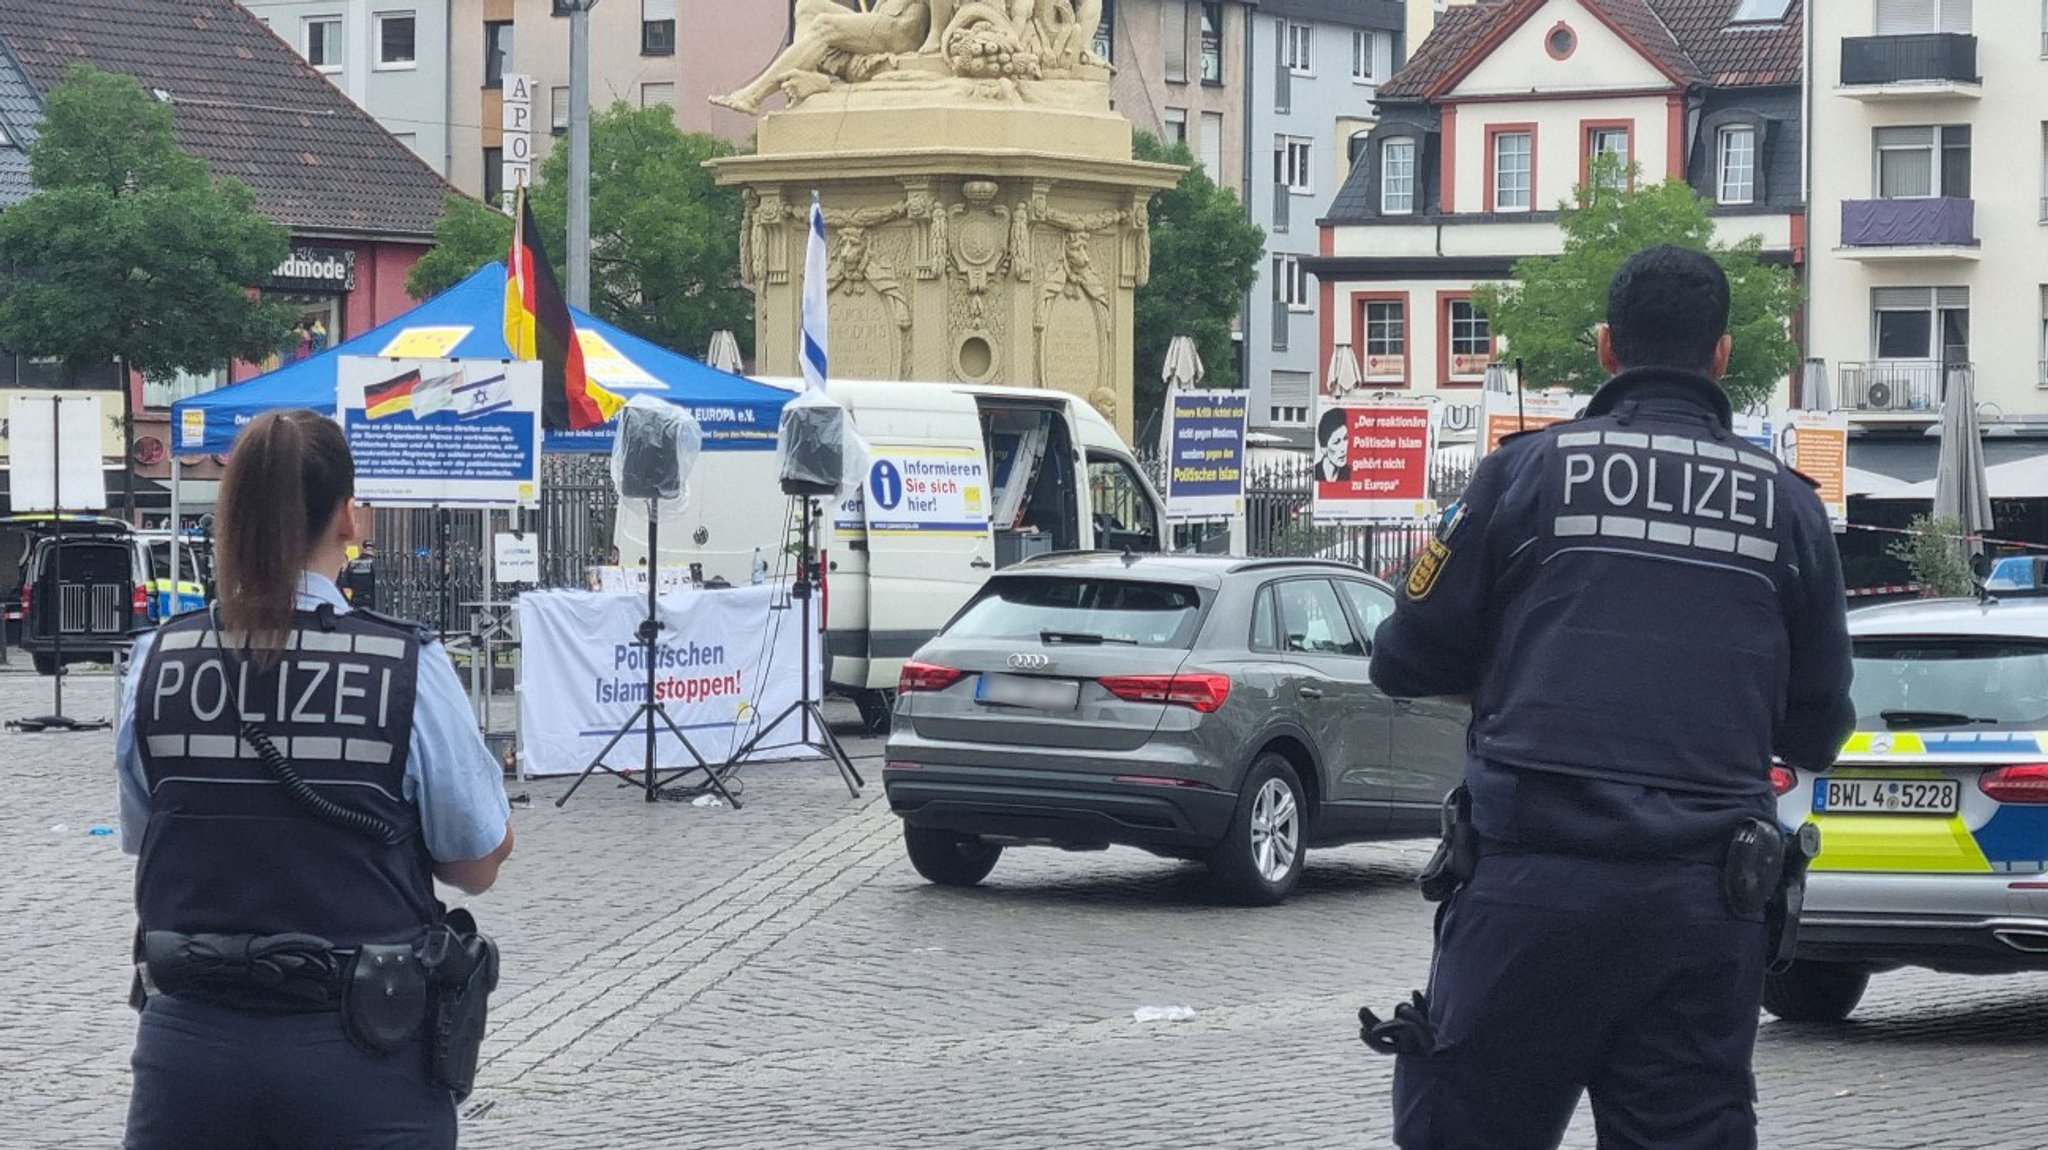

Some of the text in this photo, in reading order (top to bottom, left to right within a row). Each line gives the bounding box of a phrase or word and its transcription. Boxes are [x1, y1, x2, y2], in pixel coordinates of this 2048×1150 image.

[513, 77, 528, 186] APOT
[695, 408, 735, 421] EUROPA
[738, 409, 755, 423] e.V.
[1376, 415, 1426, 428] reaktionäre
[1353, 436, 1422, 449] Politische Islam
[903, 460, 981, 476] Informieren
[1352, 458, 1405, 471] gehört nicht
[1174, 466, 1239, 482] Politischen Islam
[905, 478, 957, 494] Sie sich
[1352, 481, 1362, 491] zu
[1564, 452, 1774, 529] POLIZEI
[907, 497, 938, 512] hier!
[153, 659, 391, 728] POLIZEI
[595, 669, 741, 703] Islam stoppen!
[1828, 783, 1954, 809] BWL 4 5228
